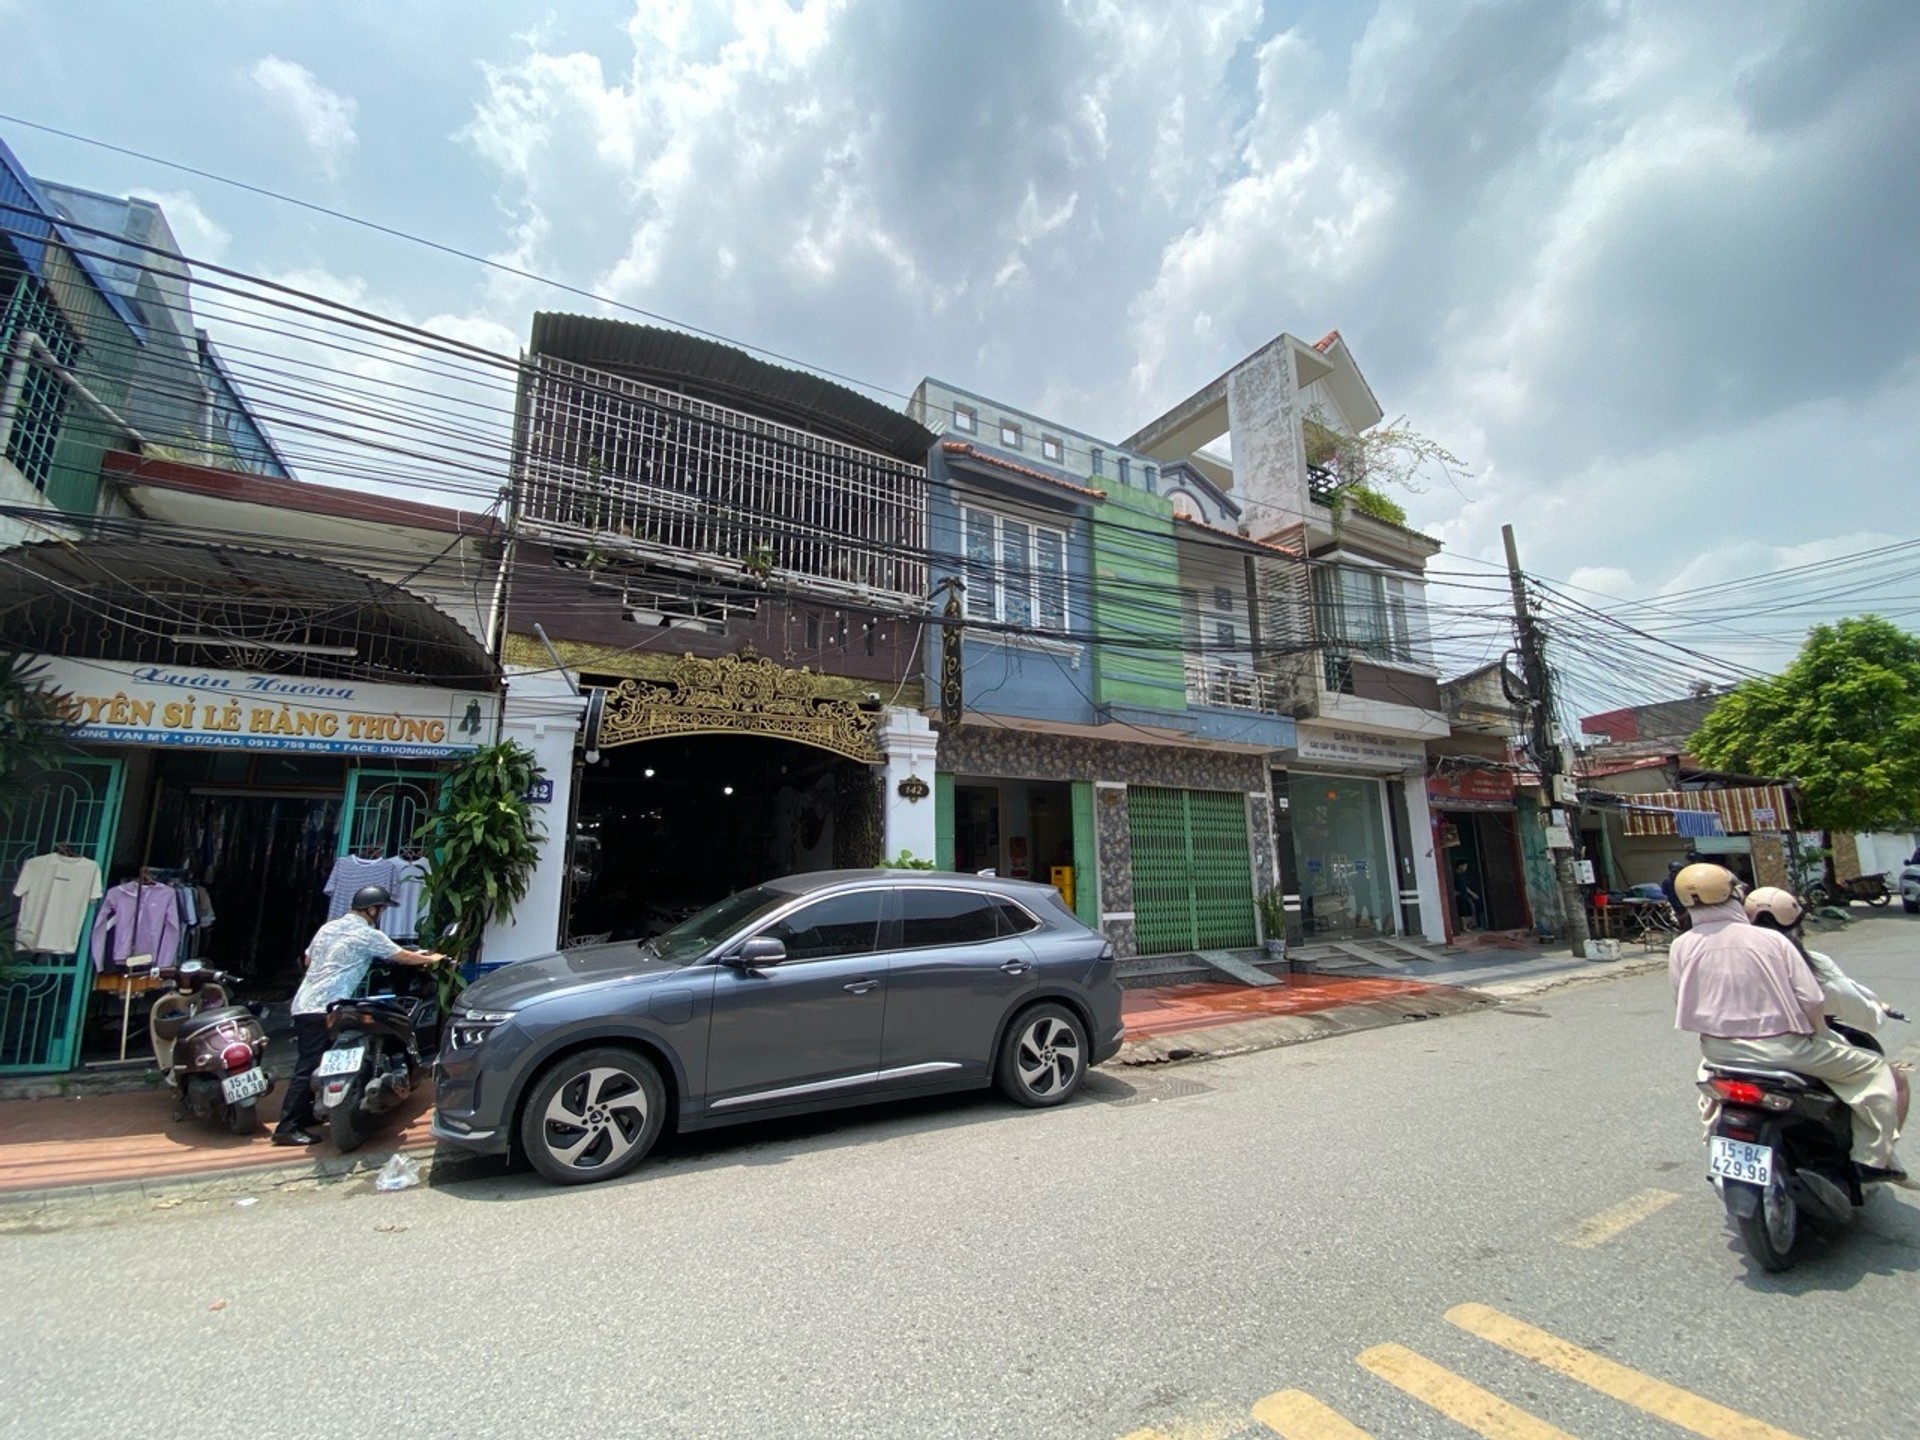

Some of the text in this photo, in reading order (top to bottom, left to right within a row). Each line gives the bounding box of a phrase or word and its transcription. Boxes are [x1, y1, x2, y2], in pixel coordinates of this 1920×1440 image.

[249, 703, 339, 737] HÀNG
[347, 711, 446, 743] THÙNG
[248, 738, 277, 747] 0912
[905, 785, 923, 795] 142
[1720, 1141, 1762, 1164] 15-B4
[1712, 1157, 1767, 1183] 429.98
